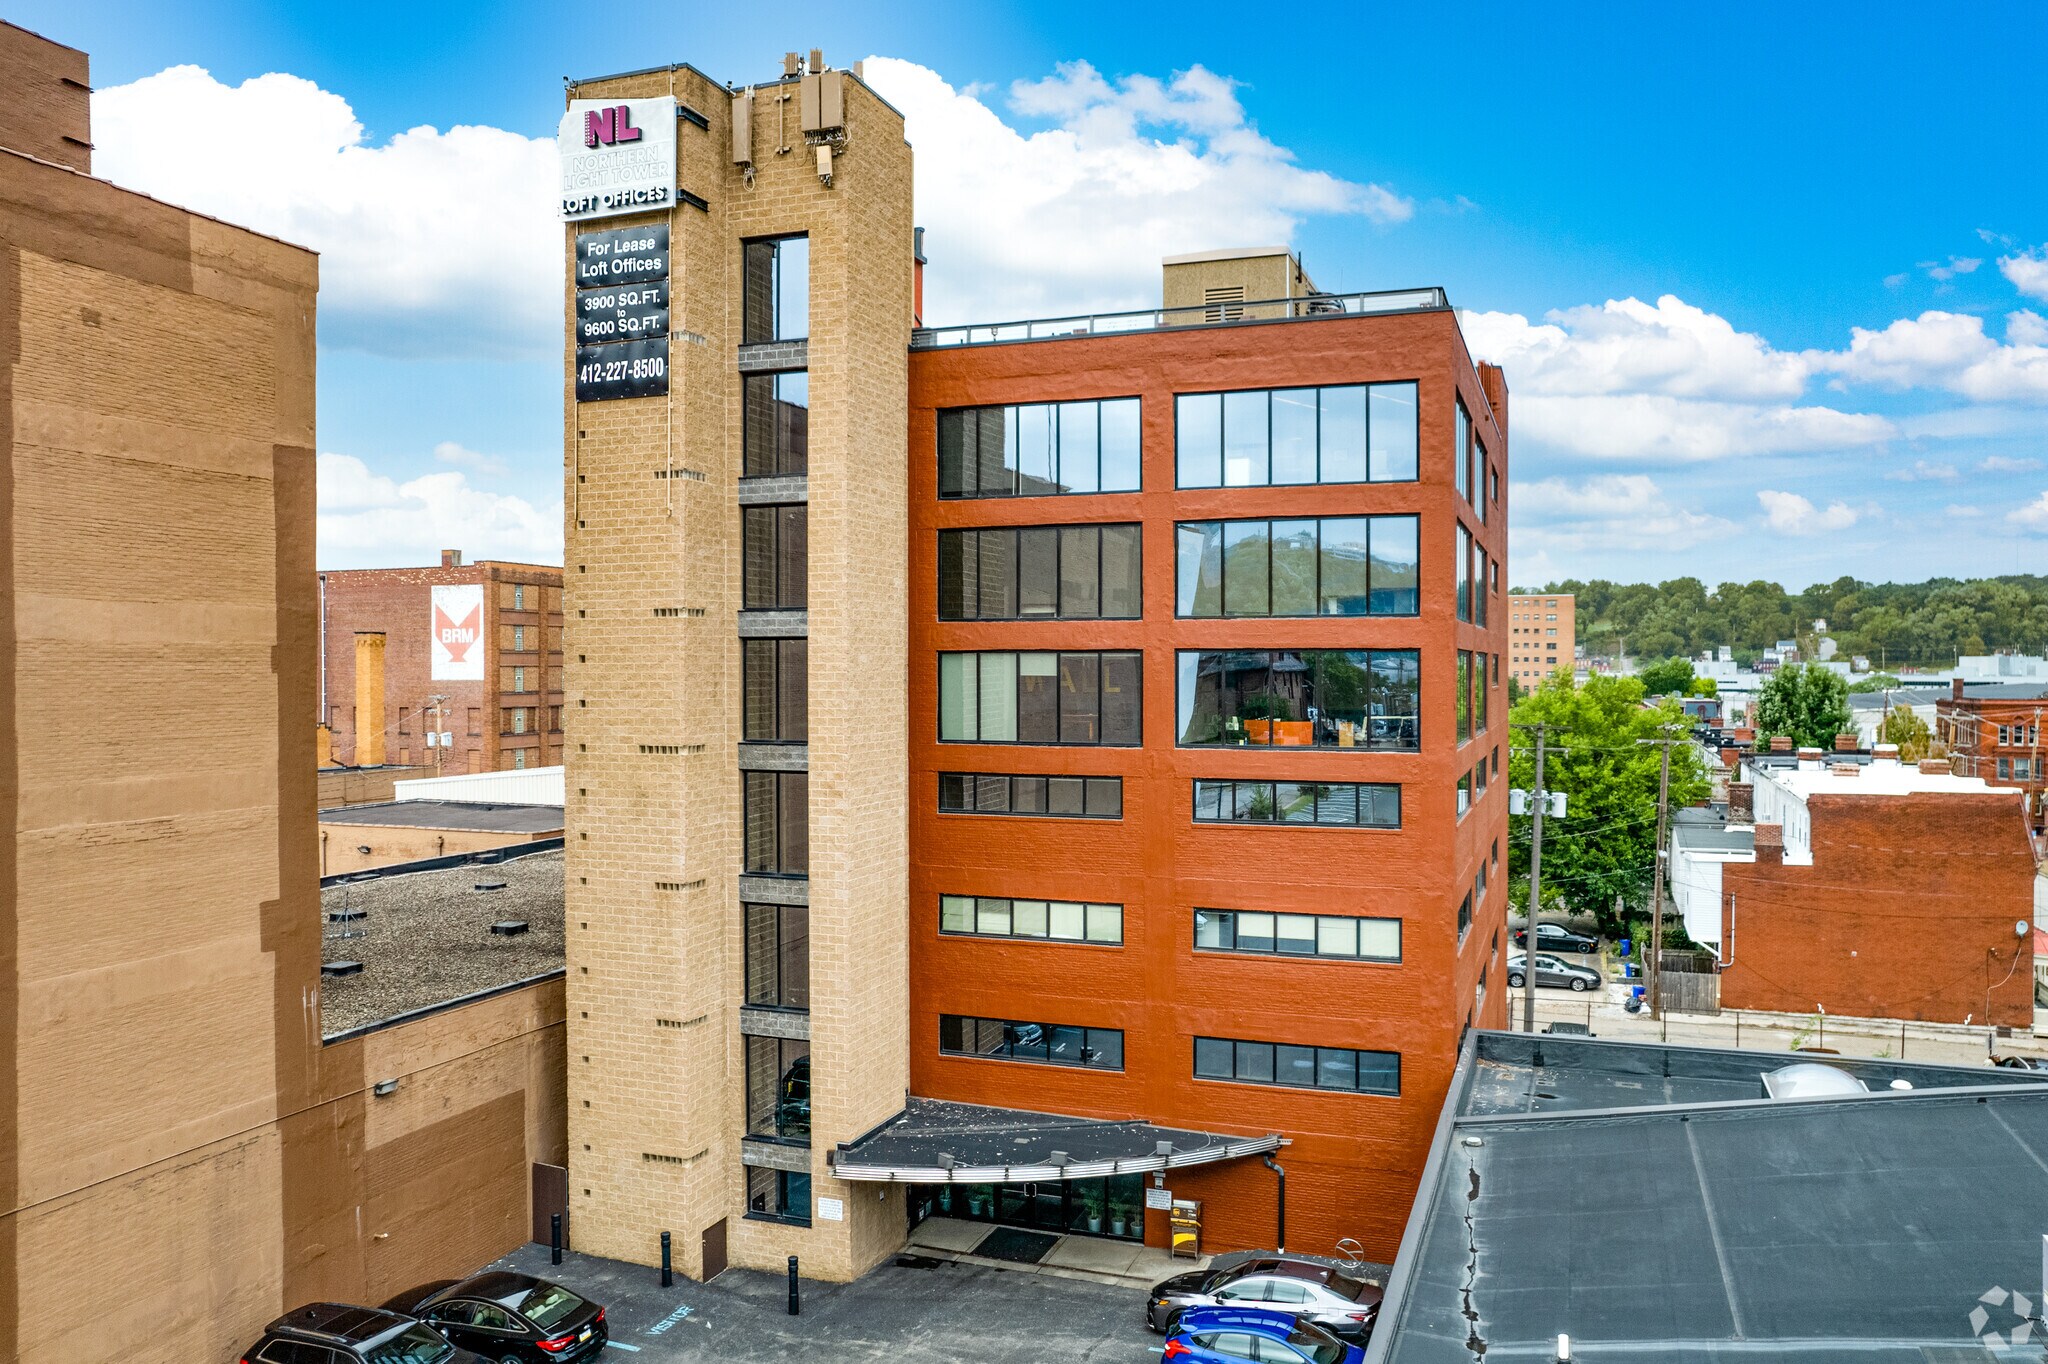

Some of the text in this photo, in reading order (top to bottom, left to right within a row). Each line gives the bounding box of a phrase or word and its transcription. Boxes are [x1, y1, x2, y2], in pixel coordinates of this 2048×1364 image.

[585, 105, 642, 149] NL
[573, 145, 659, 173] NORTHERN
[564, 161, 668, 191] LIGHT TOWER
[562, 186, 668, 214] LOFT OFFICES
[588, 238, 656, 257] For Lease
[582, 257, 662, 277] Loft Offices
[585, 290, 660, 311] 3900 SQ.FT.
[617, 309, 626, 318] to
[584, 316, 660, 336] 9600 SQ.FT.
[581, 357, 664, 384] 412-227-8500
[441, 628, 474, 644] BRM
